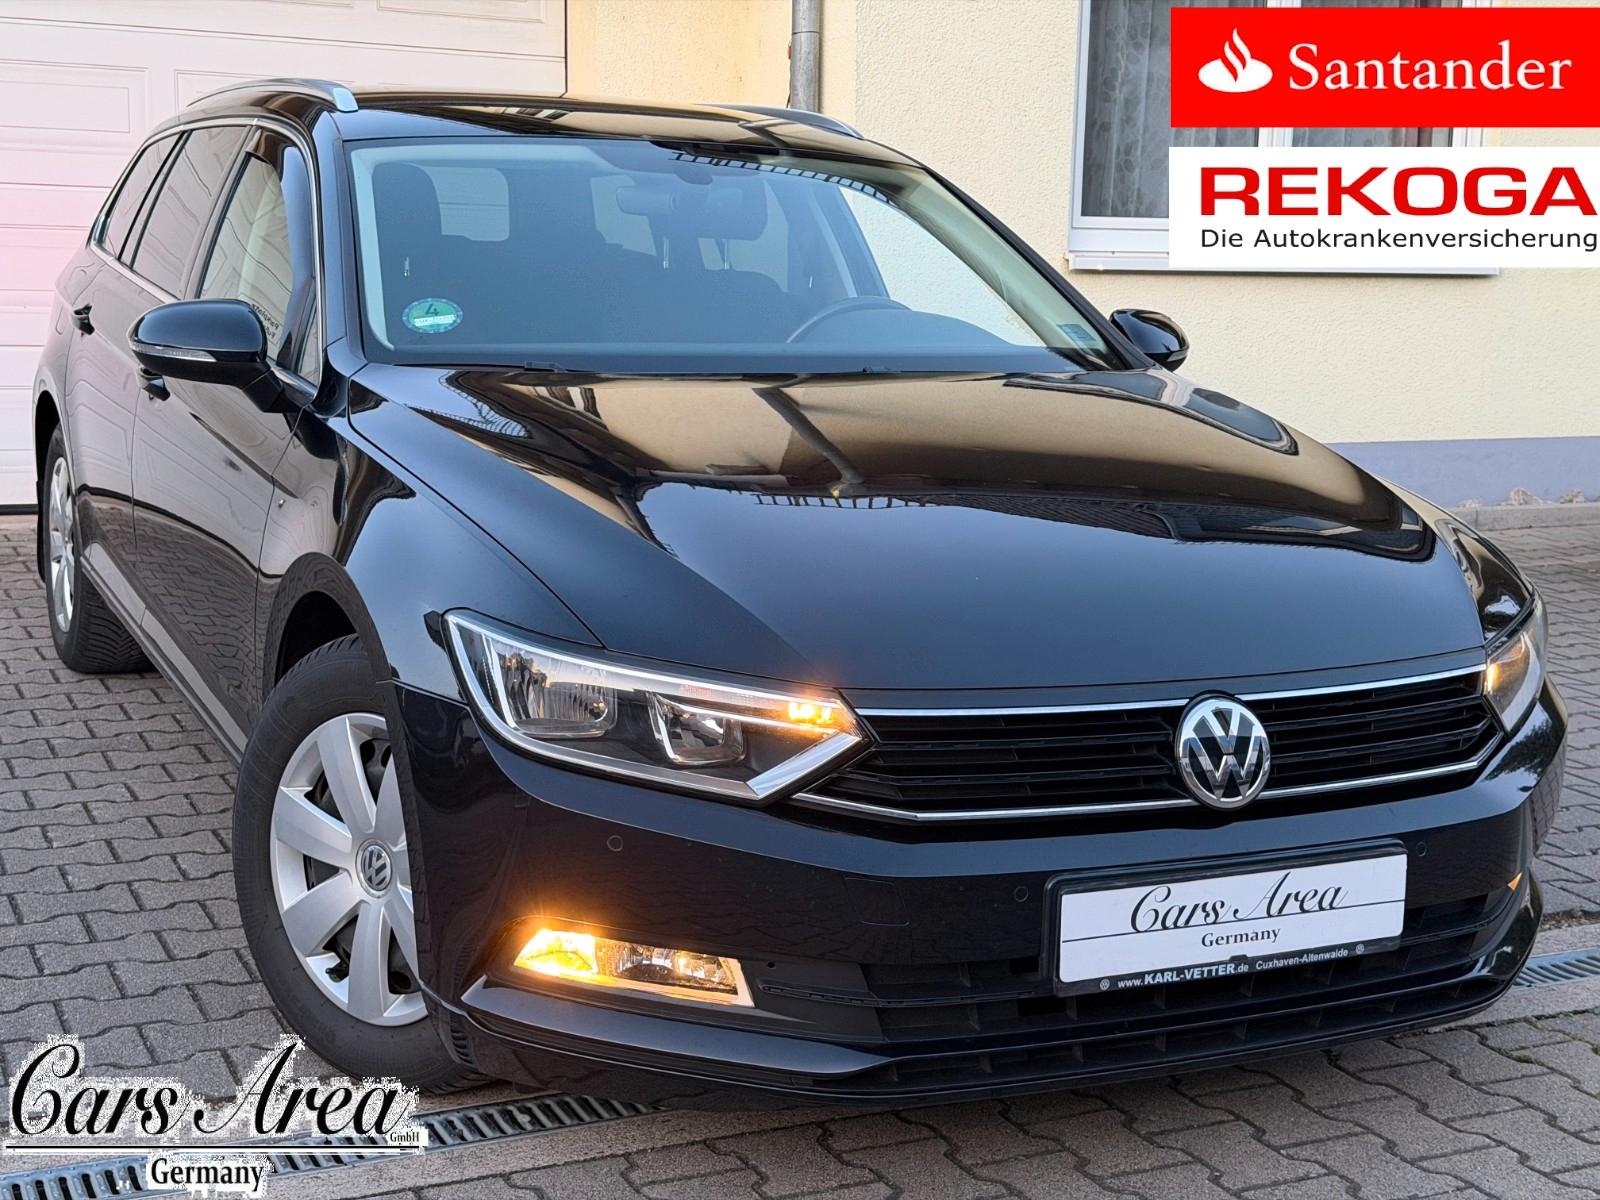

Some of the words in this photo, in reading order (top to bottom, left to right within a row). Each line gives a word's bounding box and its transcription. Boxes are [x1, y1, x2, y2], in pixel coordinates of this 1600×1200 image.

[425, 303, 440, 316] 4
[1181, 702, 1269, 806] VW
[1130, 885, 1231, 933] Cars
[1233, 871, 1350, 918] Area
[1201, 928, 1281, 948] Germany
[1117, 963, 1249, 988] www.KARL-VETTER.de
[1255, 947, 1348, 970] Cuxhaven-Altenwalde
